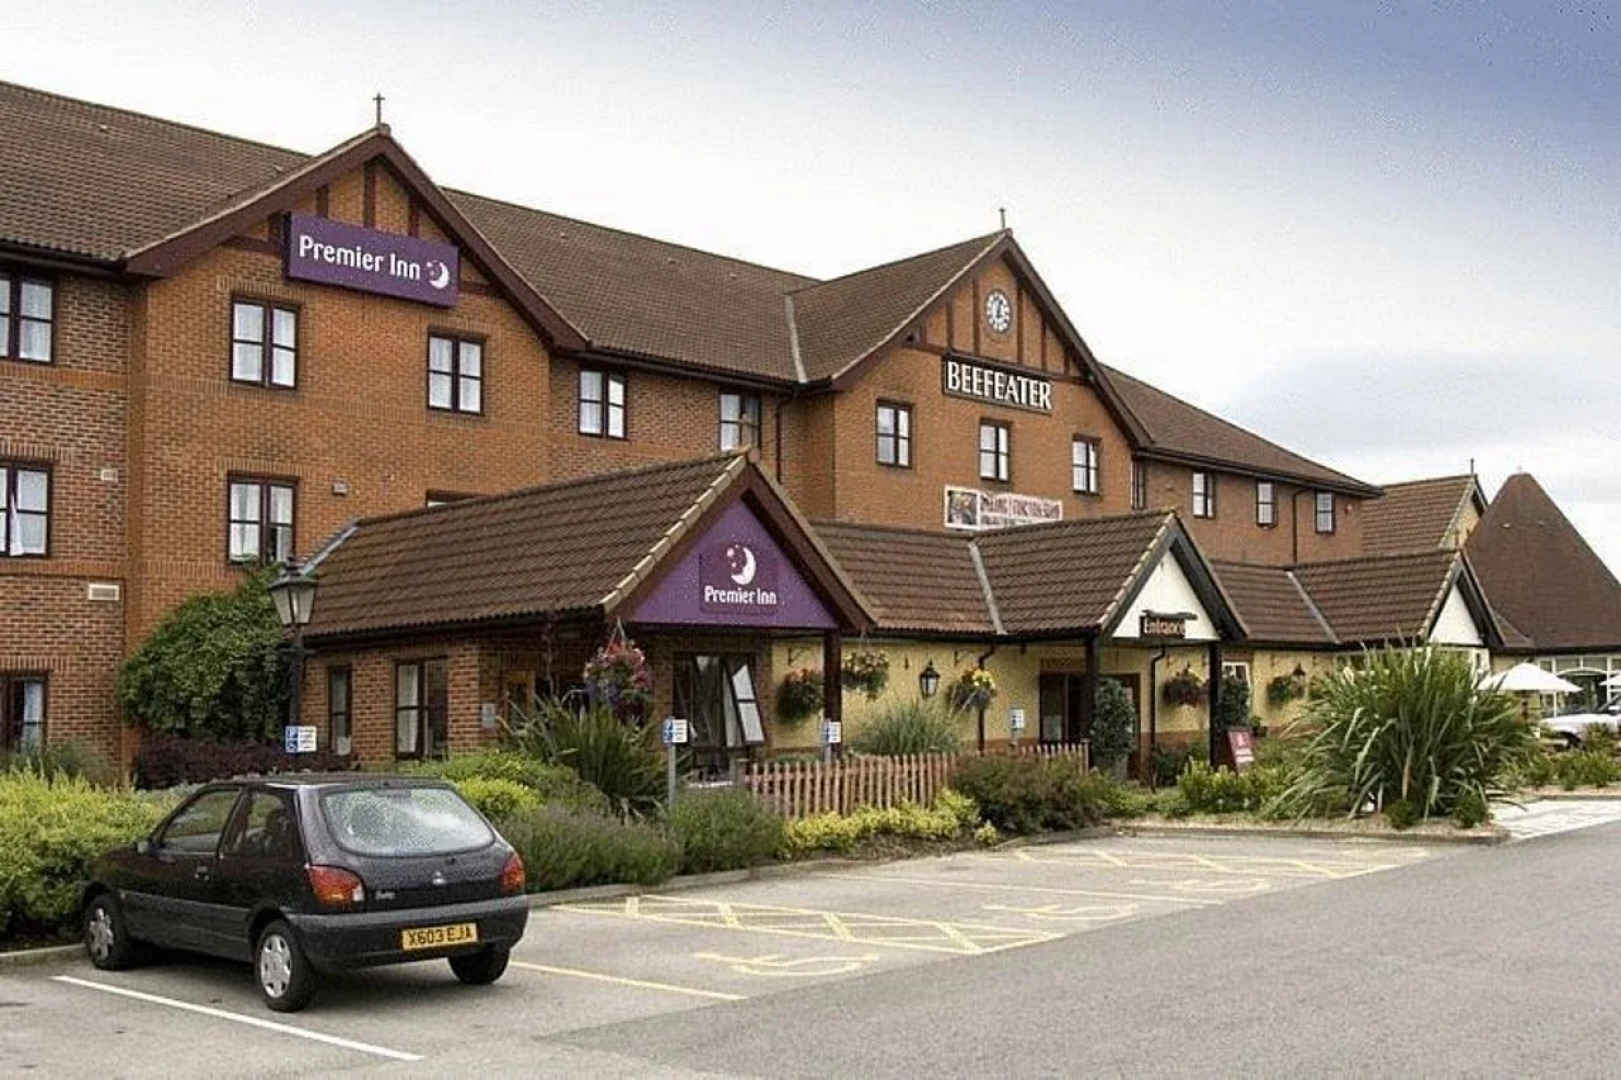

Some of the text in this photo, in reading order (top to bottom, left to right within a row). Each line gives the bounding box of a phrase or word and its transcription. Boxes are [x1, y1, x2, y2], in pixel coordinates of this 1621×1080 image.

[299, 234, 420, 280] Premier Inn
[947, 361, 1052, 410] BEEFEATER
[704, 585, 777, 605] Premier Inn
[407, 926, 473, 947] X603 EJA
